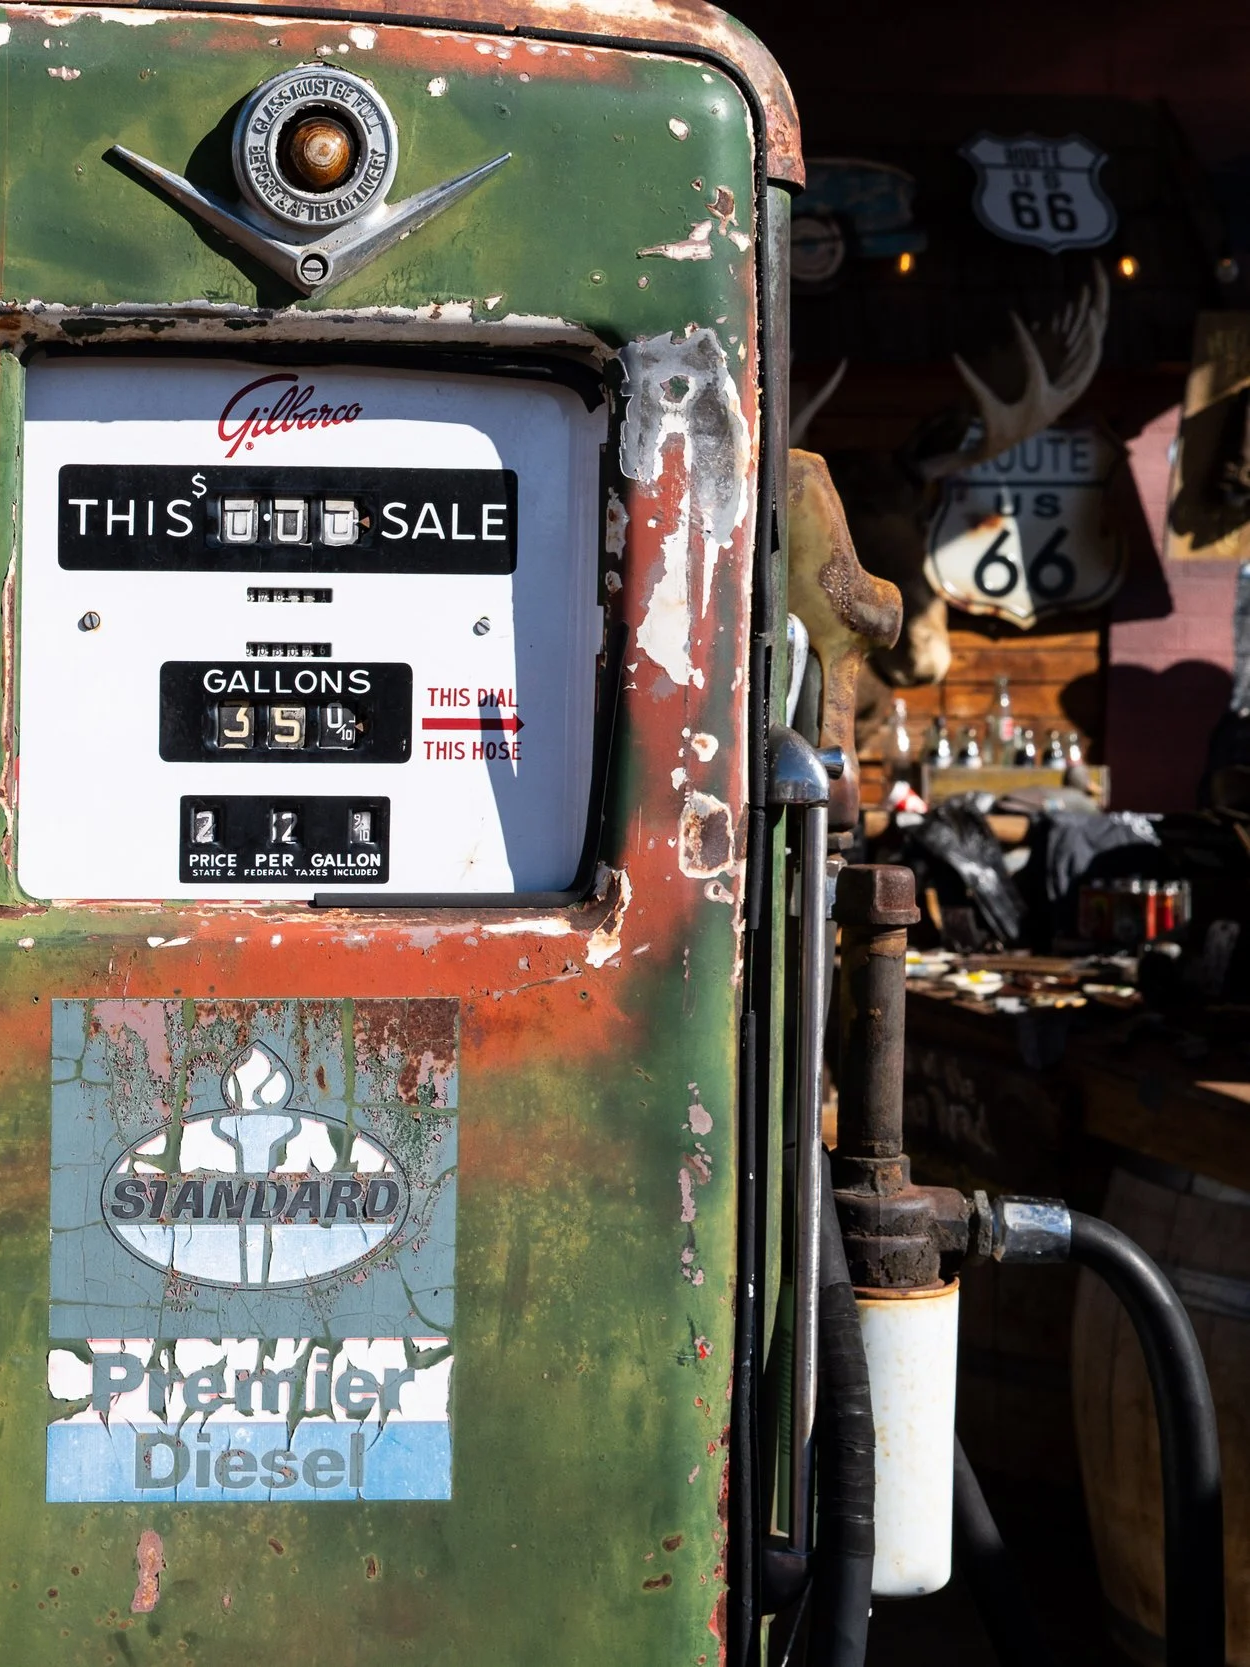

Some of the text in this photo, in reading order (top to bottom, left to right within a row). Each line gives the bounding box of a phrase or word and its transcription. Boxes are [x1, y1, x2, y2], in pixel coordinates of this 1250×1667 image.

[252, 78, 383, 135] GLASS MUST BE FULL
[250, 144, 281, 203] BEFORE
[287, 201, 338, 222] AFTER
[336, 148, 386, 213] DELIVERY
[1011, 191, 1079, 232] 66
[217, 373, 363, 458] Gilbarco
[971, 436, 1090, 474] OUTE
[68, 499, 194, 538] THIS
[381, 501, 507, 541] SALE
[974, 527, 1076, 599] 66
[203, 669, 372, 694] GALLONS
[427, 687, 519, 707] THIS DIAL
[423, 741, 522, 760] THIS HOSE
[189, 853, 381, 867] PRICE PER GALLON
[192, 869, 379, 877] STATE & FEDERAL TAXES INCLUDED
[110, 1178, 401, 1220] STANDARD
[89, 1351, 417, 1413] Premier
[132, 1431, 365, 1491] Diesel
